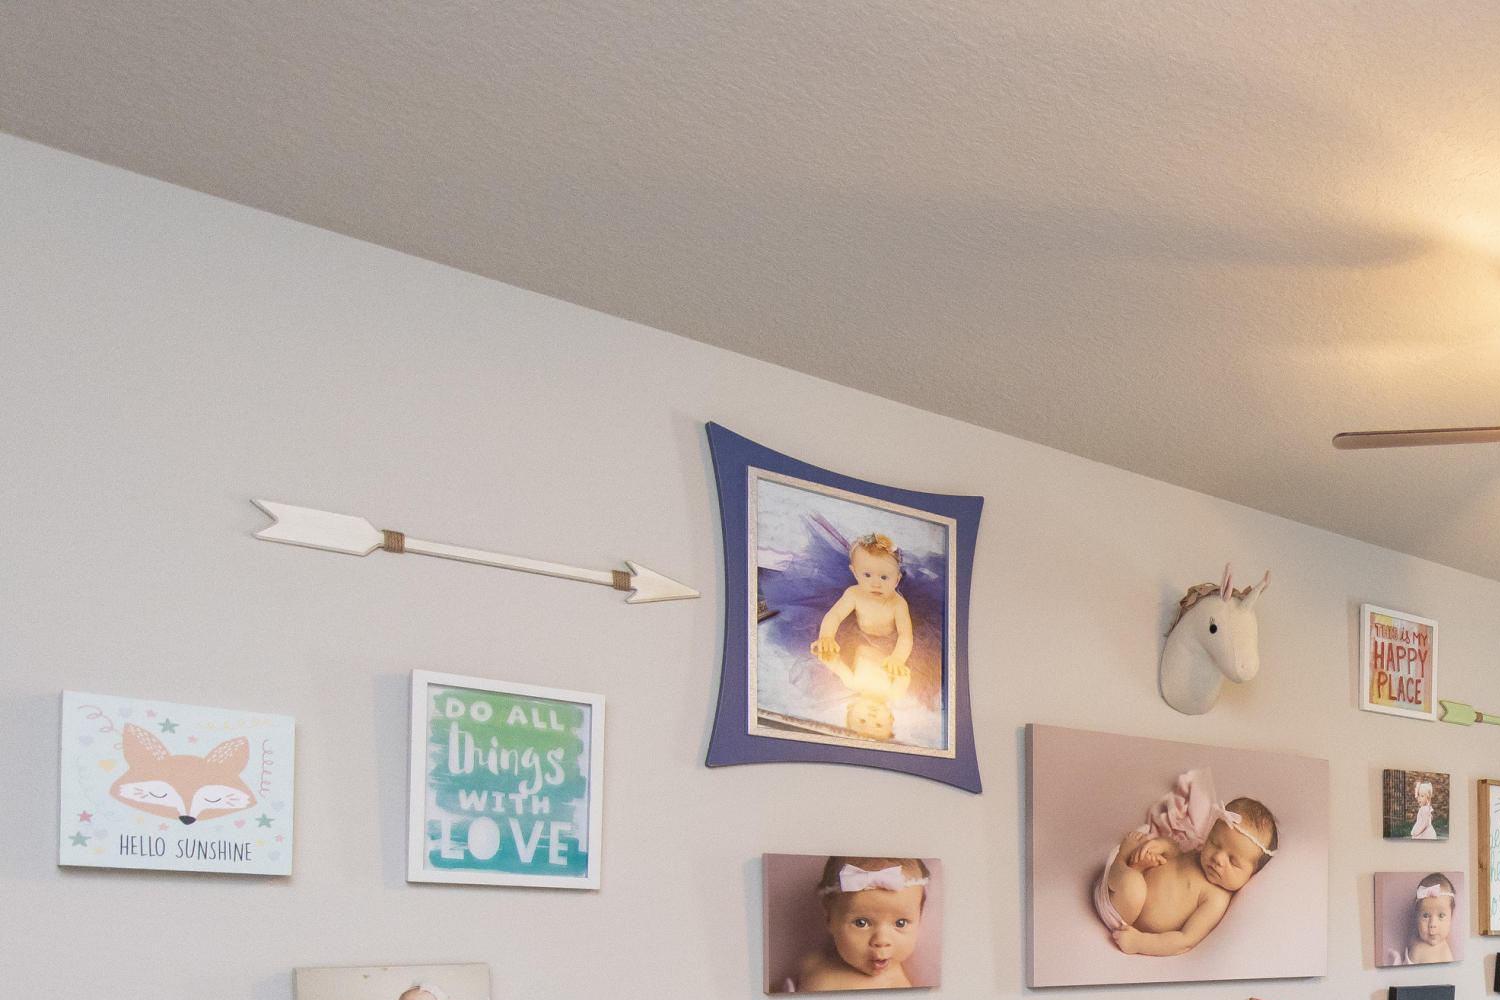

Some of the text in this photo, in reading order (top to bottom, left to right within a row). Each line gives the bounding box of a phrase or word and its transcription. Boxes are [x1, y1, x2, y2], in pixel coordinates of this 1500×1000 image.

[1412, 631, 1428, 647] MY
[1374, 640, 1428, 678] HAPPY
[1377, 671, 1422, 704] PLACE
[445, 697, 565, 731] DO ALL
[448, 721, 566, 795] things
[458, 789, 551, 815] WITH
[119, 833, 252, 862] HELLO SUNSHINE
[440, 815, 572, 866] LOVE
